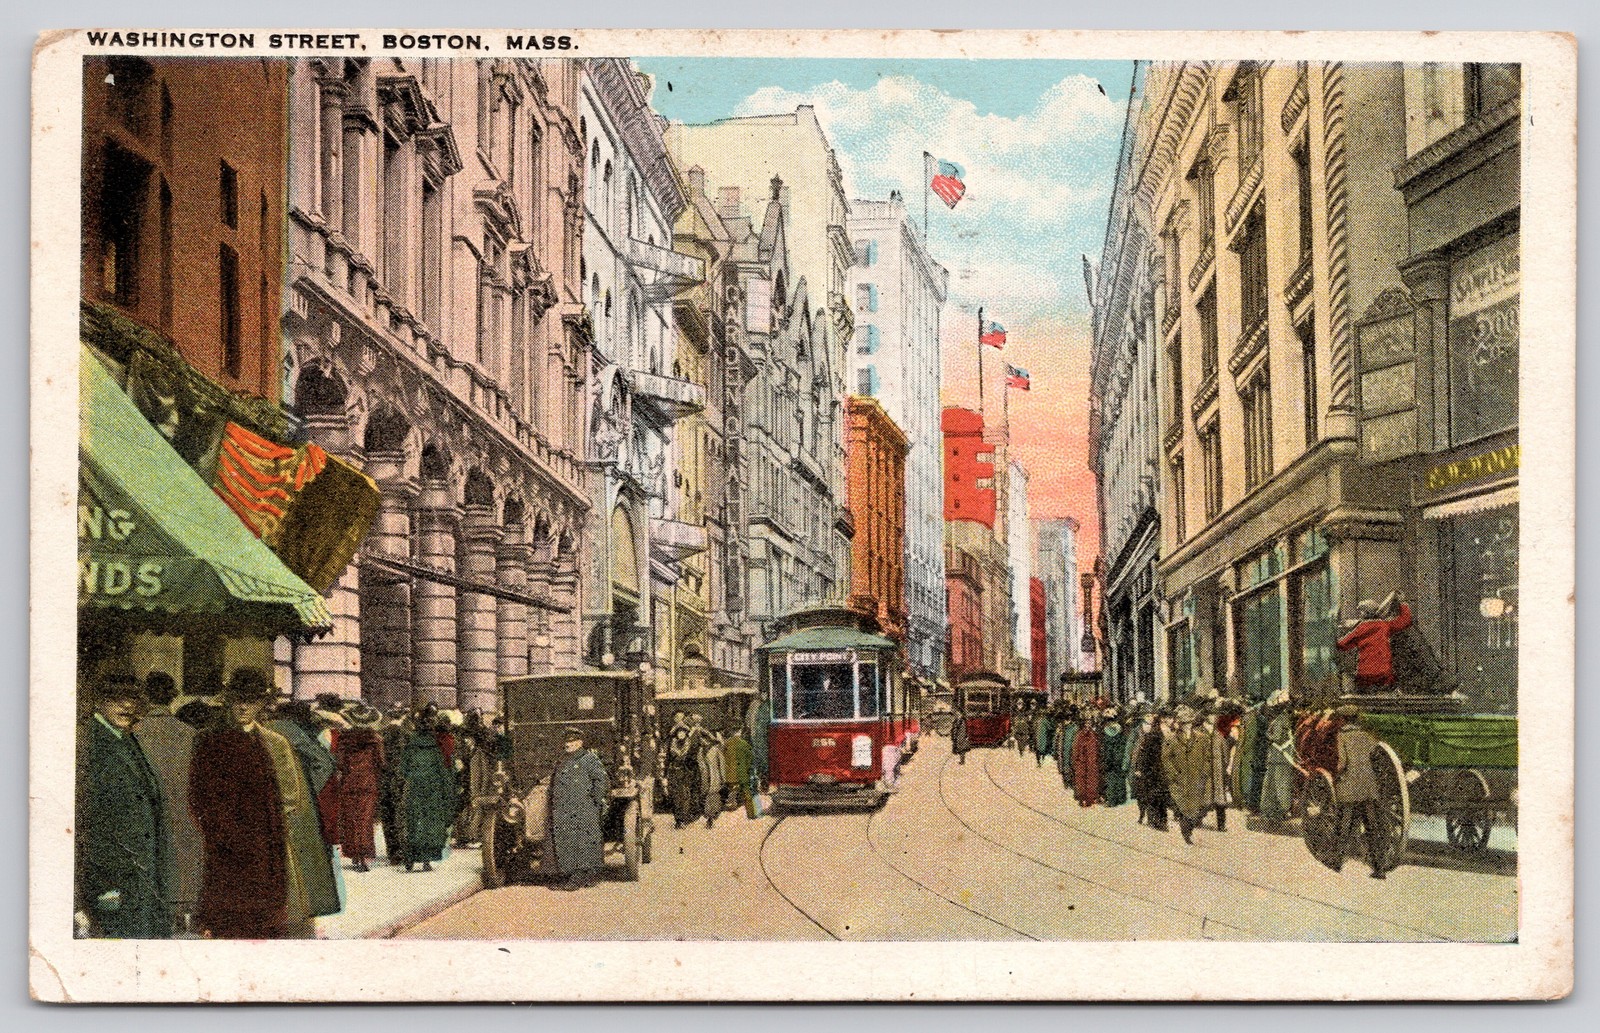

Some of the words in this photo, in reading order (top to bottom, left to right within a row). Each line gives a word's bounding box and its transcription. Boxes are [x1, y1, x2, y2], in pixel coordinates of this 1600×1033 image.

[86, 31, 254, 48] WASHINGTON
[268, 33, 366, 50] STREET,
[382, 34, 489, 51] BOSTON,
[506, 35, 578, 50] MASS.
[78, 560, 164, 597] NDS
